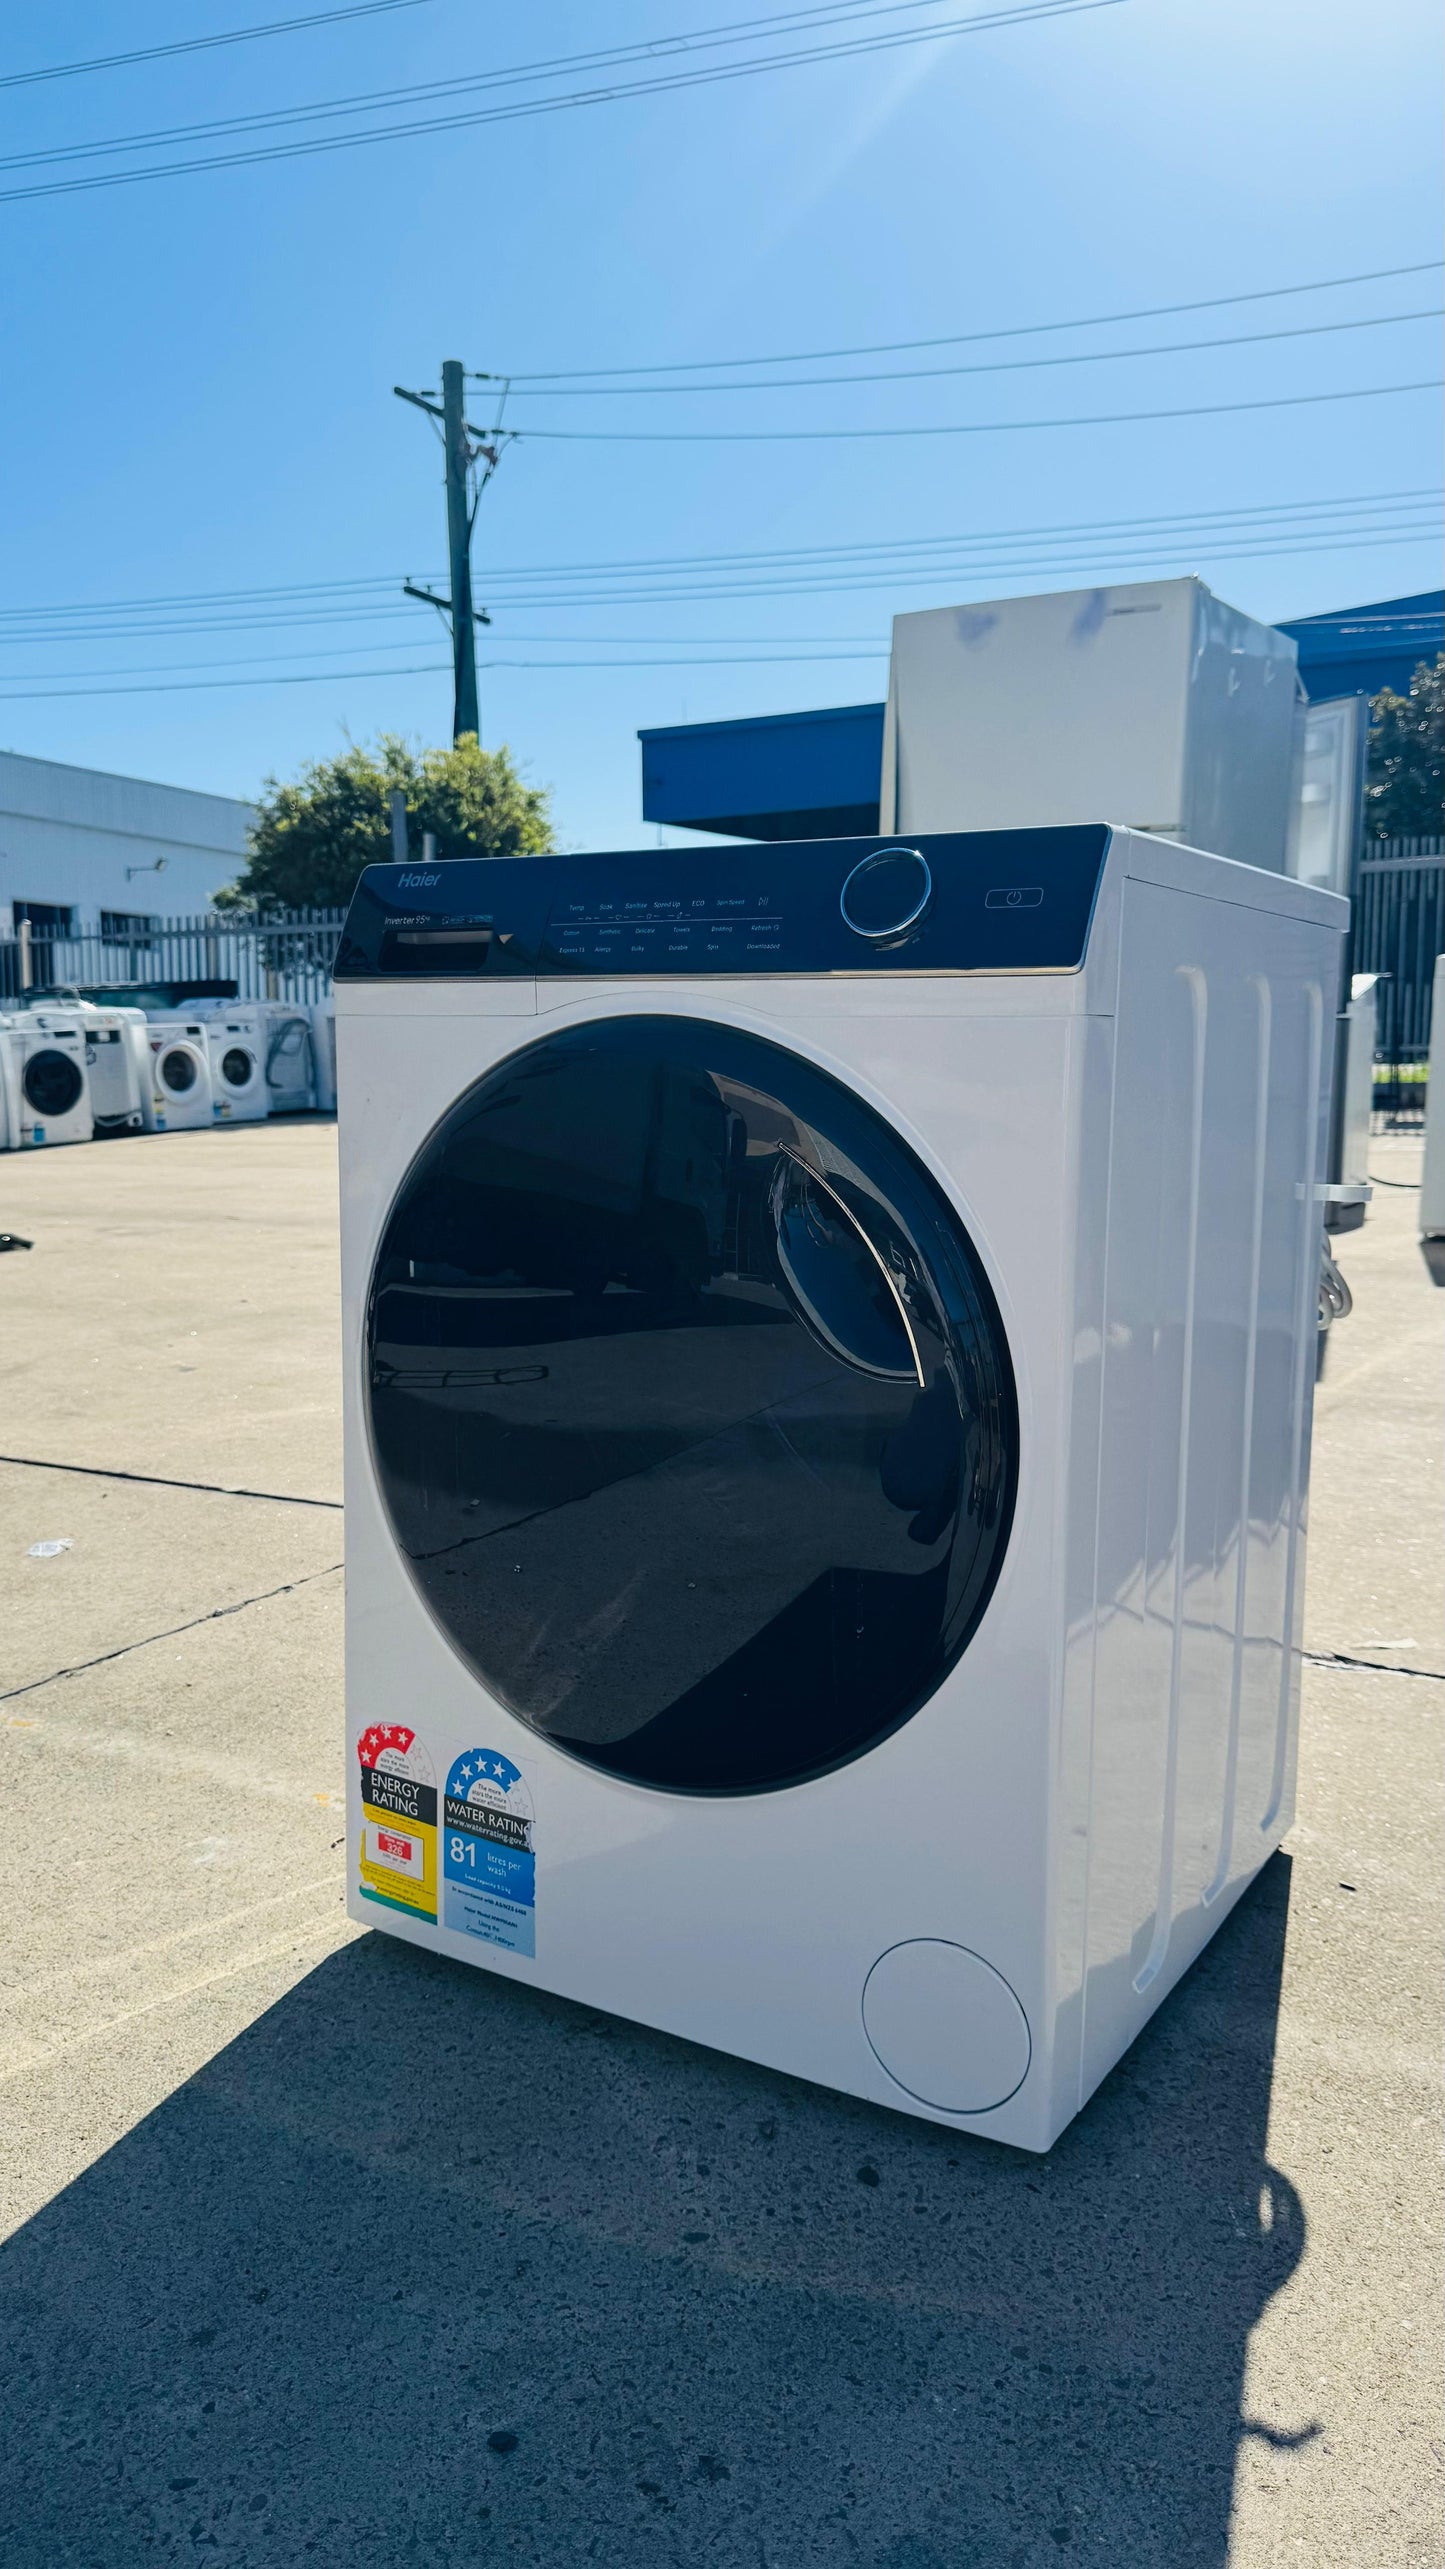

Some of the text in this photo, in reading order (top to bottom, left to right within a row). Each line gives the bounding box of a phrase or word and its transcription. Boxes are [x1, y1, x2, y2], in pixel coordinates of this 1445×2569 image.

[398, 872, 441, 888] Haier
[384, 916, 415, 926] Inverter
[371, 1772, 420, 1799] ENERGY
[478, 1783, 501, 1795] The more
[372, 1789, 418, 1816] RATING
[472, 1790, 507, 1804] stars the more
[447, 1800, 486, 1824] WATER
[450, 1837, 476, 1867] 81
[487, 1852, 521, 1871] litres per
[487, 1865, 507, 1877] wash
